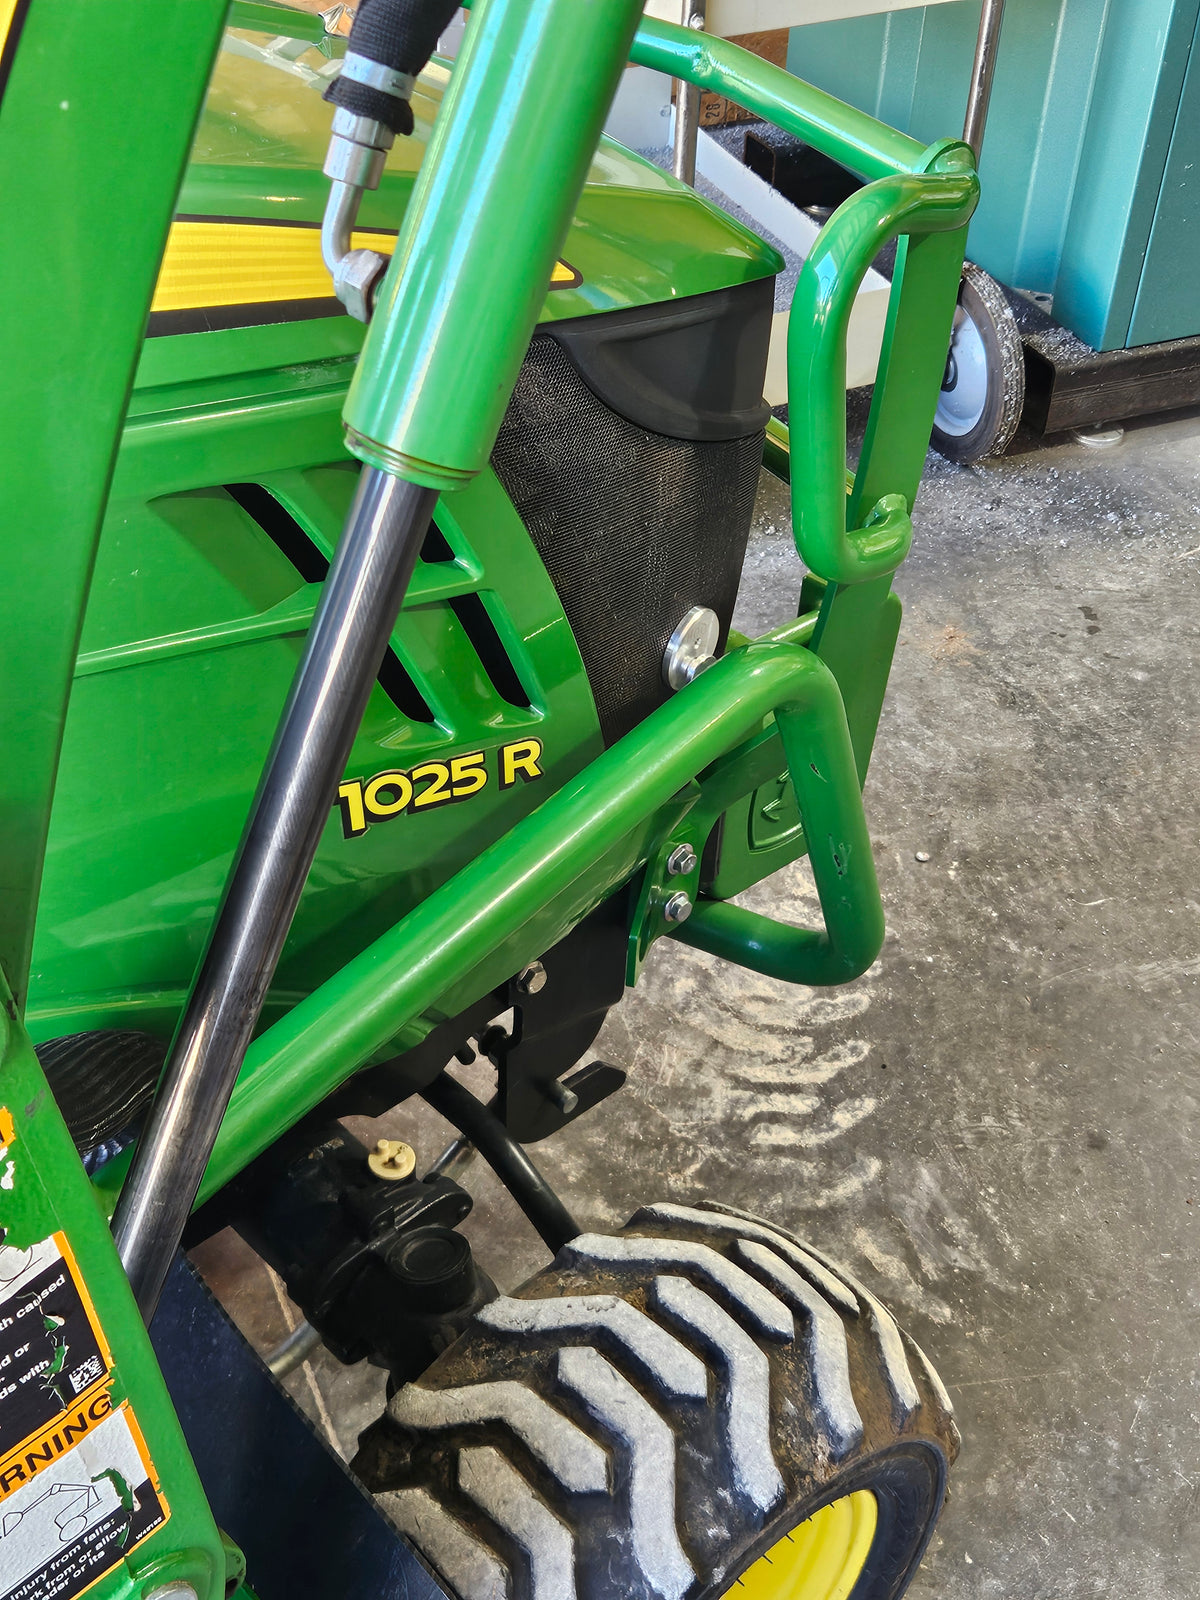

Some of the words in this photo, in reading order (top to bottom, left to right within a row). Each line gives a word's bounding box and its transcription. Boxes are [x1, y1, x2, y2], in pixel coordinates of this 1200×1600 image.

[336, 751, 489, 837] 1025
[499, 738, 544, 788] R
[16, 1274, 66, 1319] caused
[14, 1342, 31, 1357] or
[18, 1358, 50, 1384] with
[0, 1393, 111, 1497] RNING
[45, 1563, 76, 1589] from
[78, 1550, 92, 1564] or
[95, 1522, 128, 1551] allow
[50, 1545, 81, 1572] from
[83, 1518, 116, 1545] falls:
[73, 1564, 87, 1578] or
